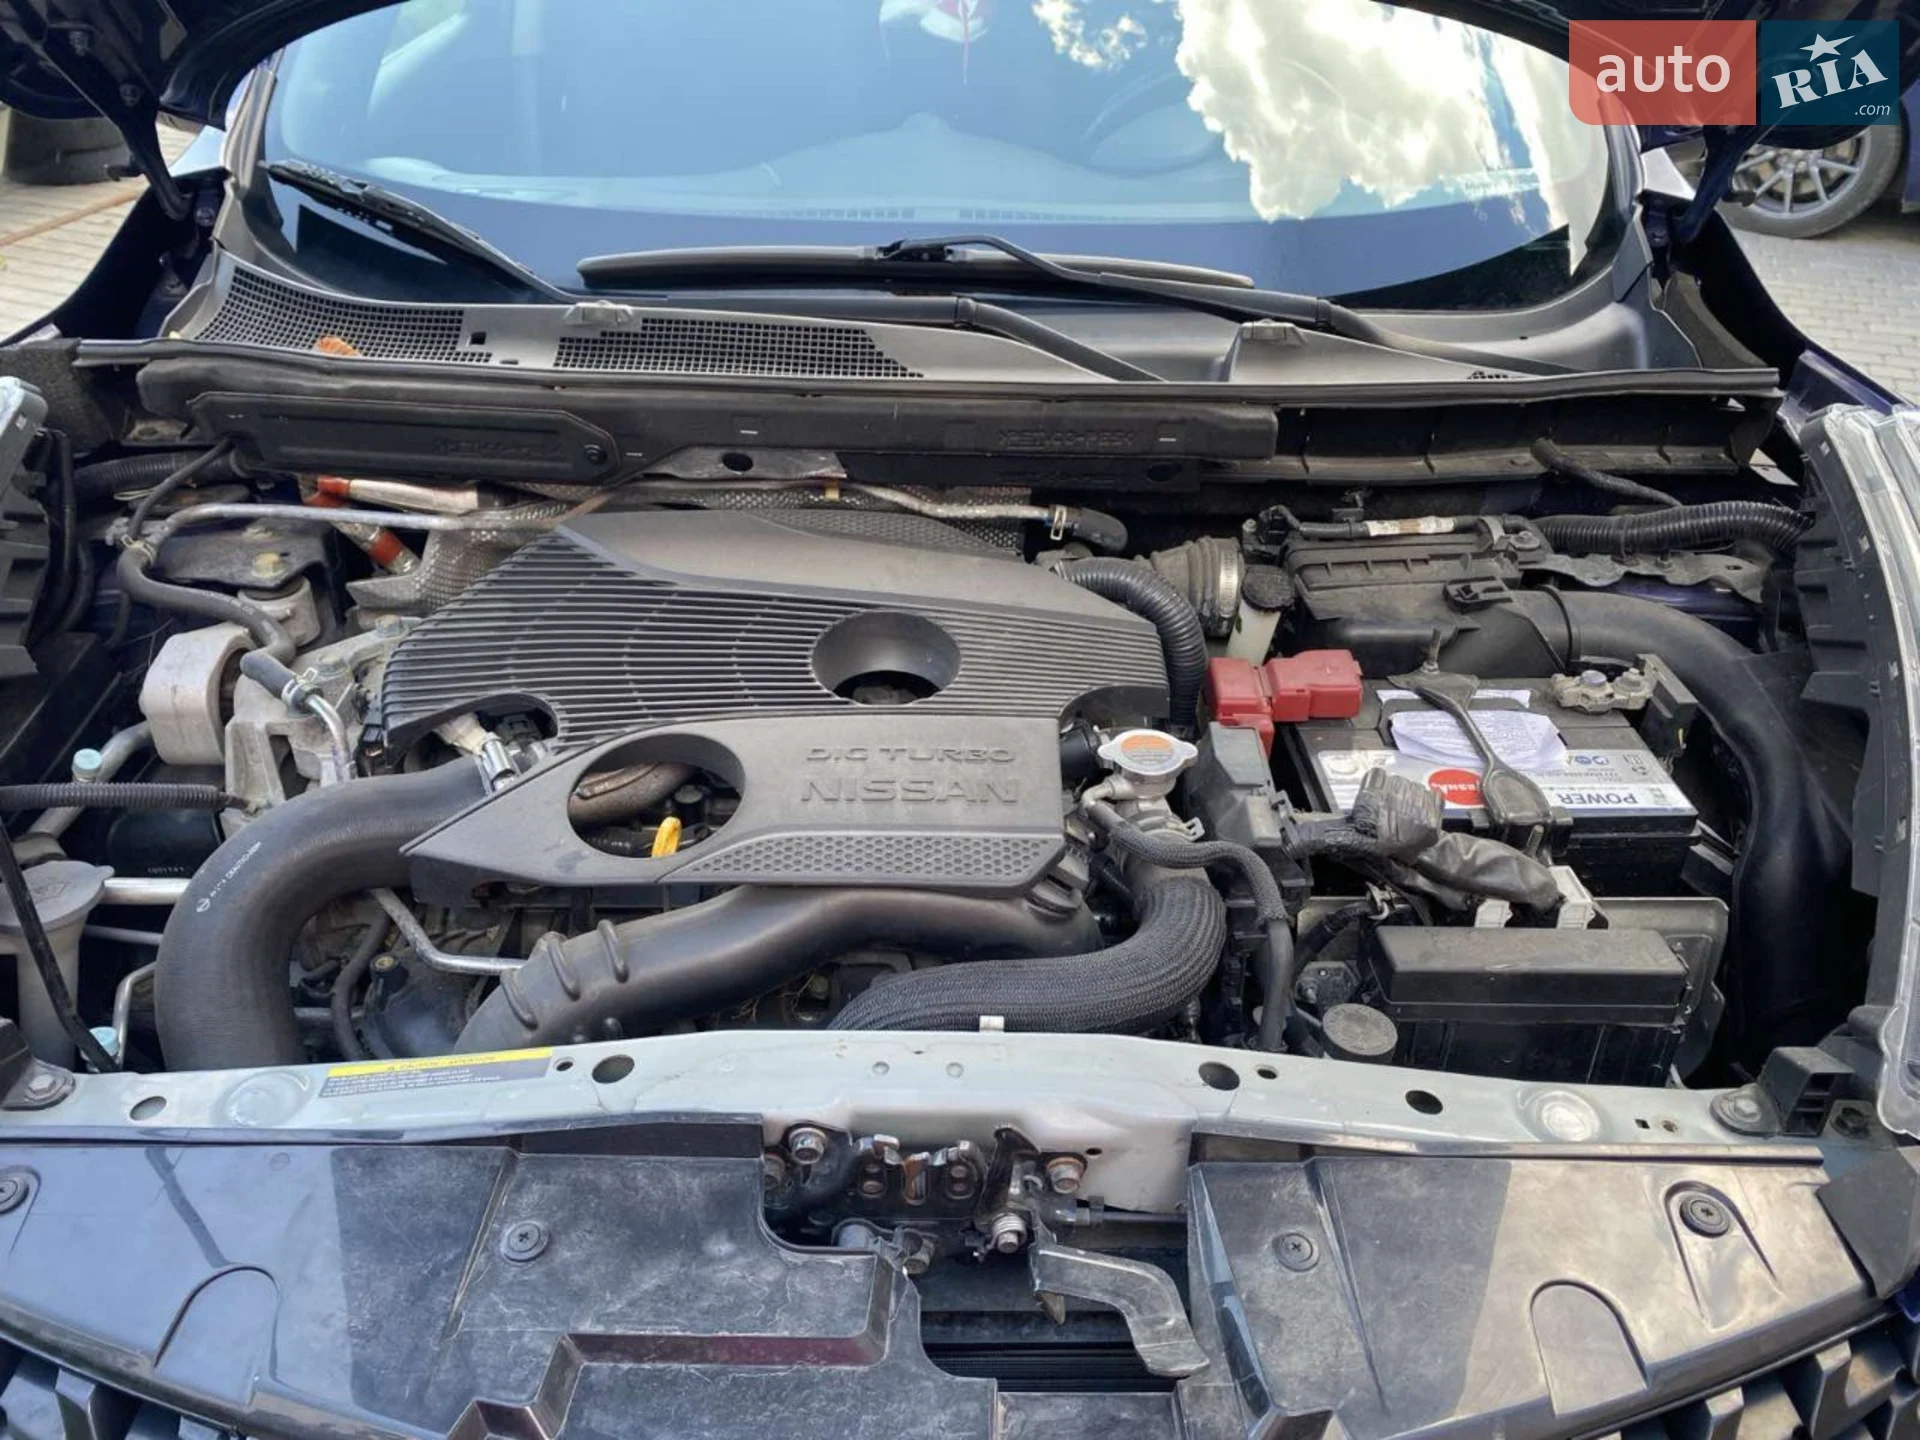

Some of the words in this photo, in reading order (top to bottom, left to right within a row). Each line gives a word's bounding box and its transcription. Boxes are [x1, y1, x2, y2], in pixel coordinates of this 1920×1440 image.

[878, 747, 1016, 763] TURBO
[800, 778, 1019, 803] NISSAN
[1557, 793, 1639, 805] POWER
